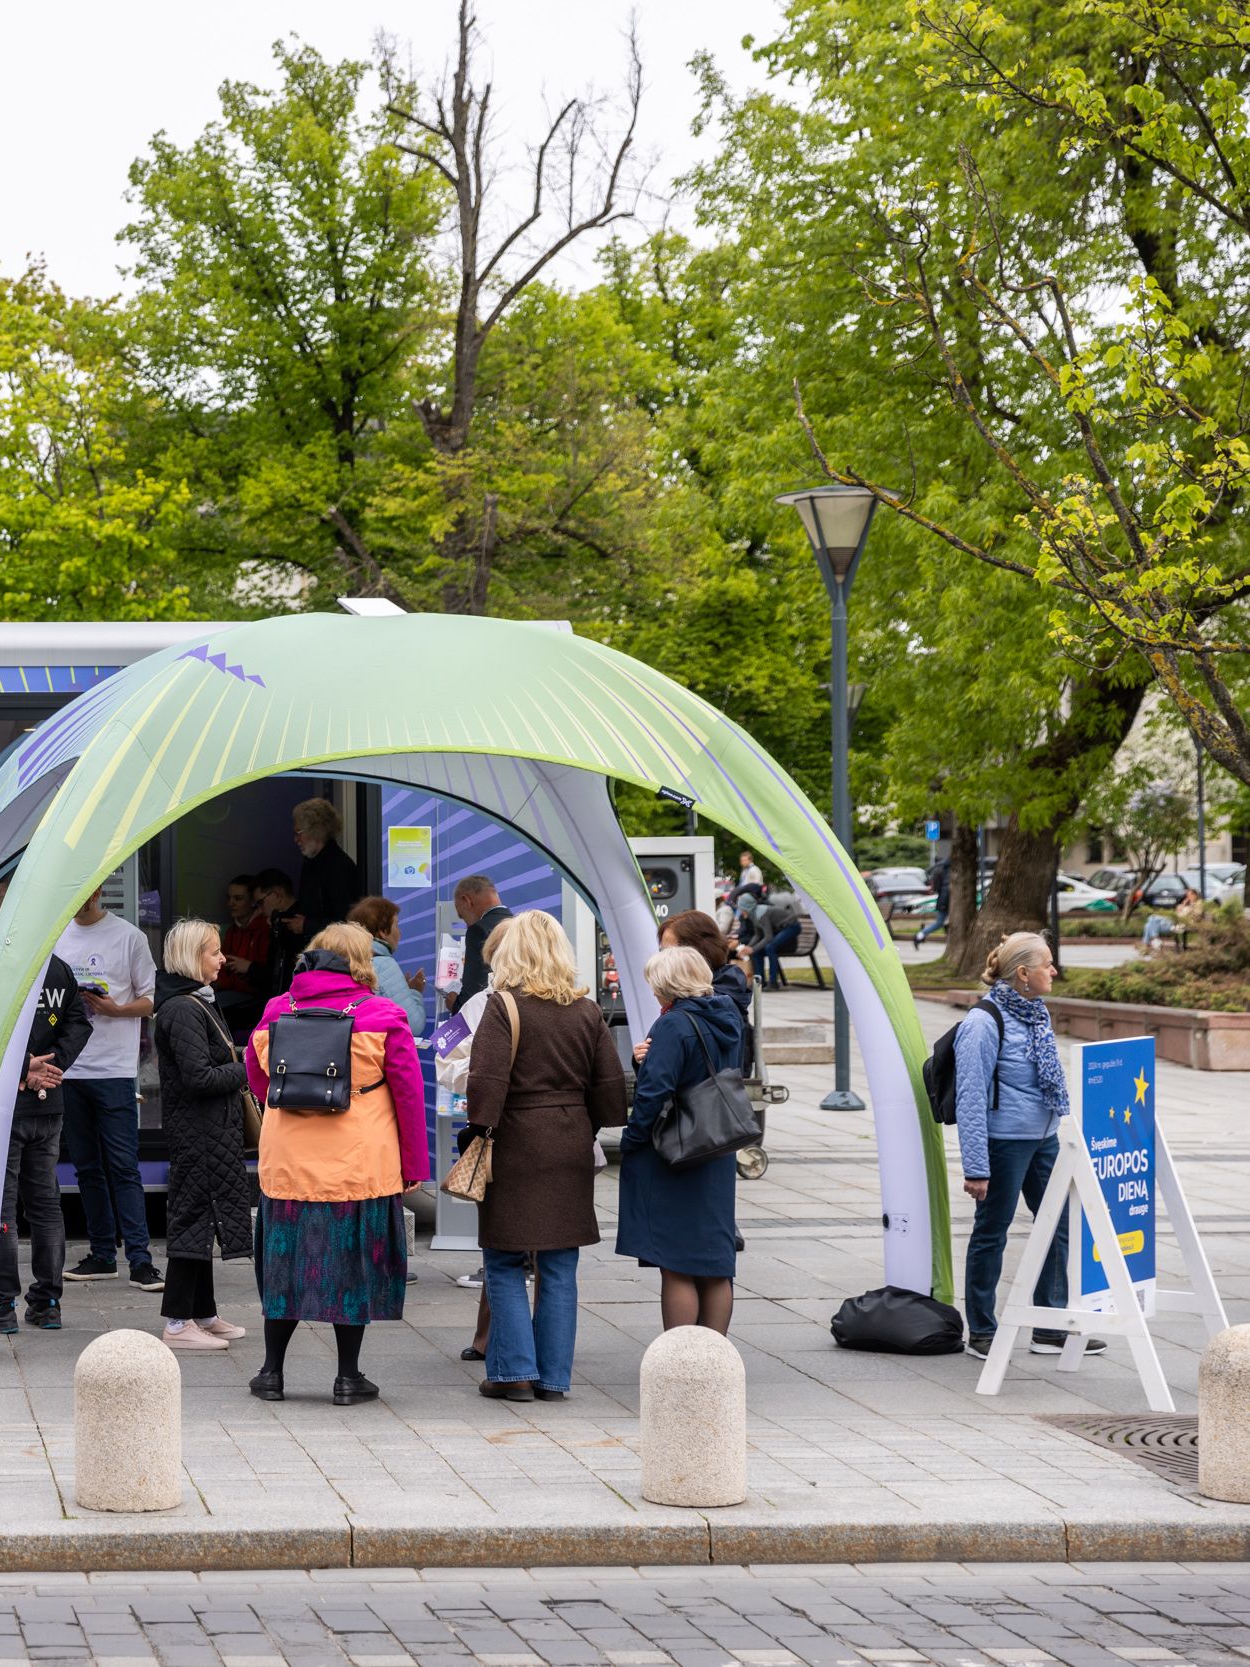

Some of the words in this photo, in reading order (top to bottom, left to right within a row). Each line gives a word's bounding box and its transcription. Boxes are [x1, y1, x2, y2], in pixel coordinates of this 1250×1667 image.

[1091, 1148, 1149, 1180] EUROPOS
[1118, 1179, 1149, 1202] DIENĄ
[1129, 1203, 1149, 1217] drauge
